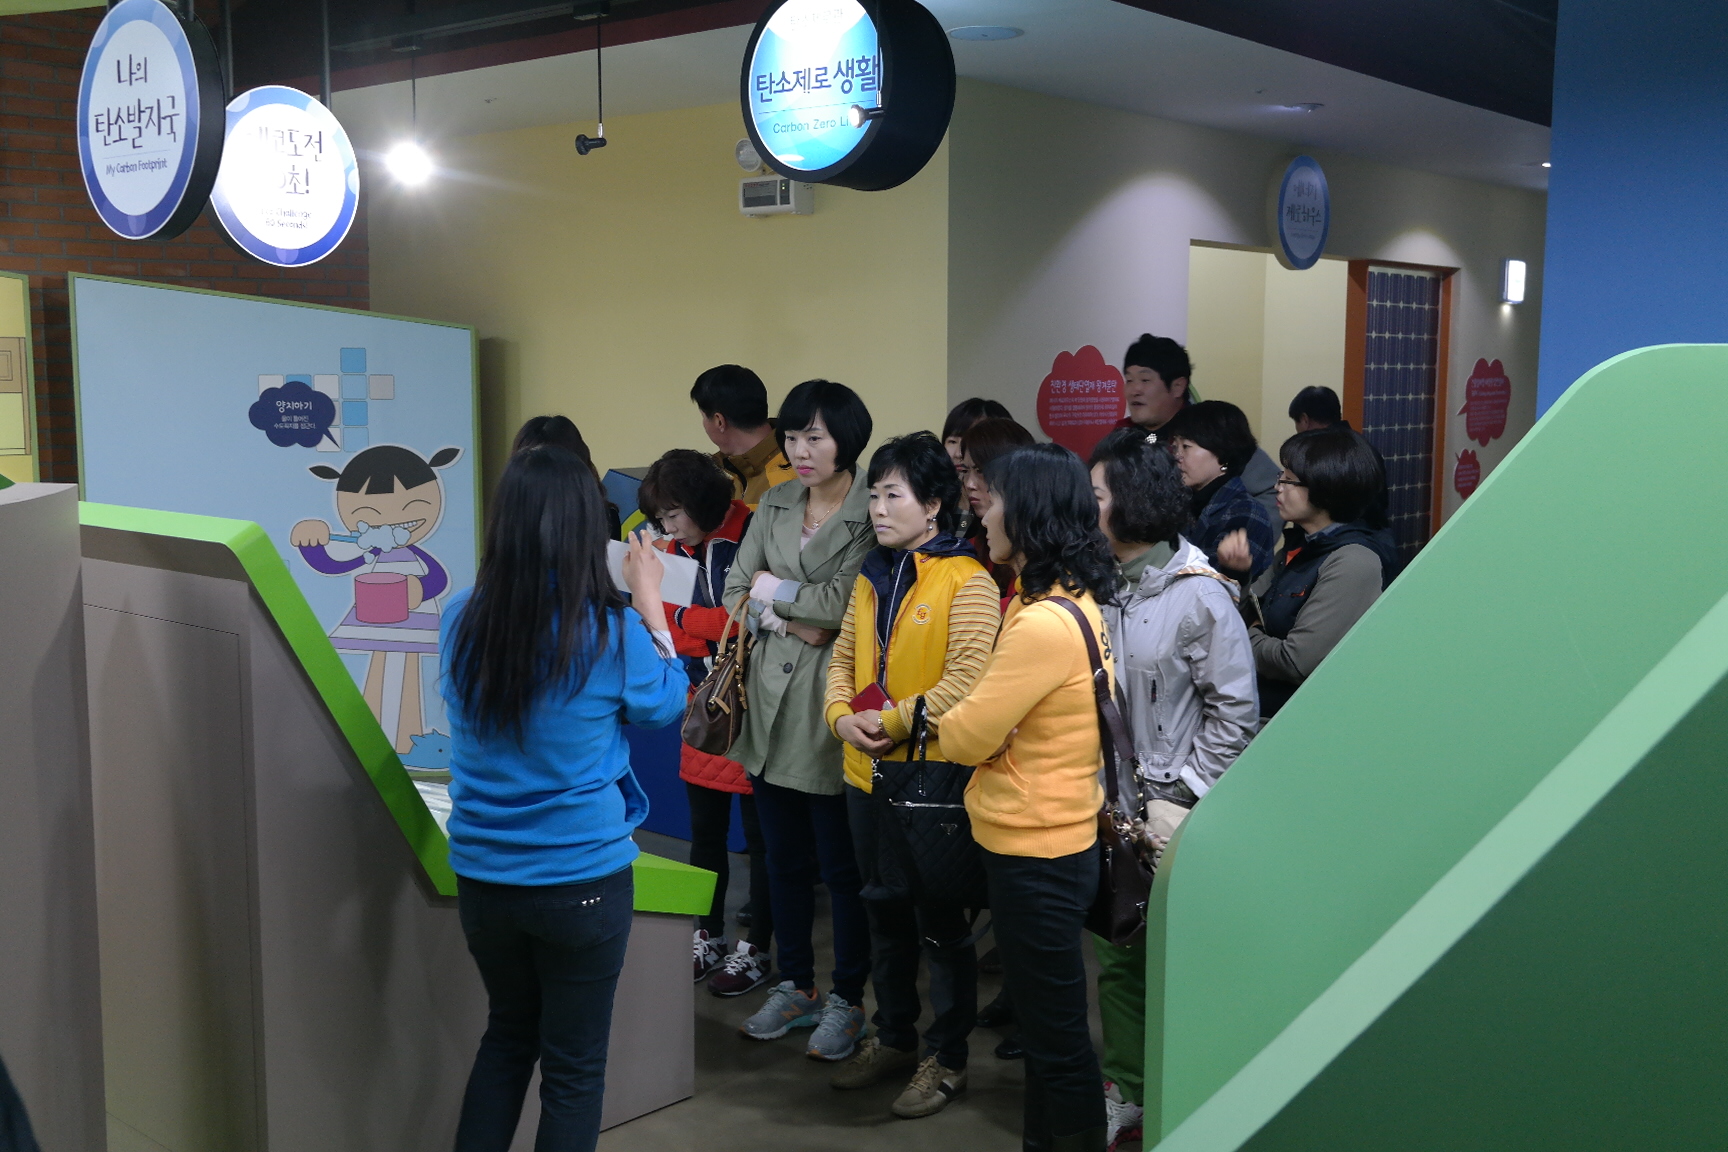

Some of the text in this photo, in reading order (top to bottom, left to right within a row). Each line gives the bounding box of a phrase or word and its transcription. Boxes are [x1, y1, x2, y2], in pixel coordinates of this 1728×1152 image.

[116, 53, 149, 87] 나의
[756, 54, 879, 103] 탄소제로 생활
[94, 95, 181, 149] 탄소발자국
[772, 121, 810, 134] Carbon
[813, 119, 837, 130] Zero
[105, 158, 168, 176] My Carbon Footprint
[1286, 203, 1322, 226] 제로하우스
[275, 400, 313, 413] 양치하기
